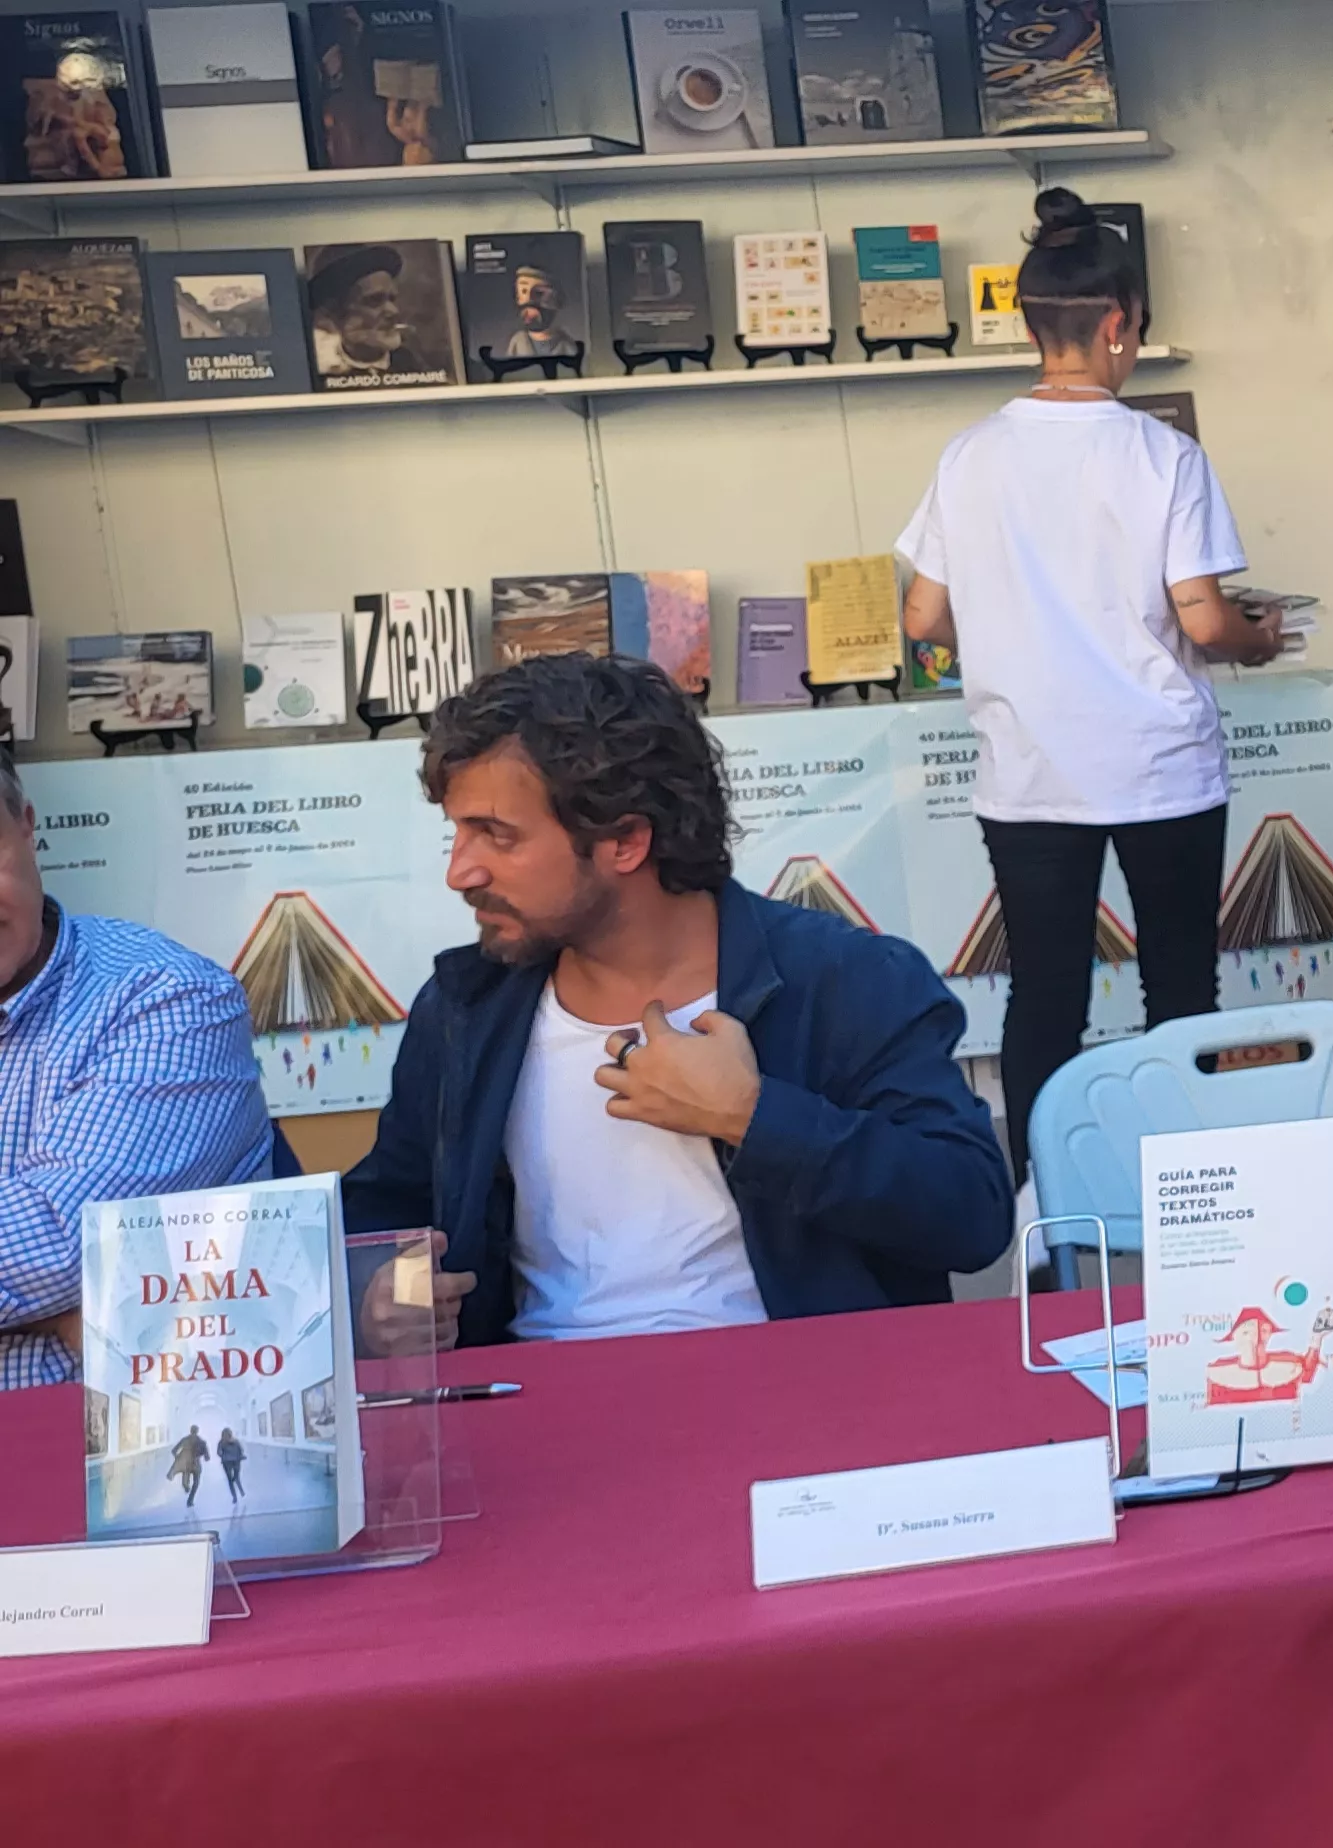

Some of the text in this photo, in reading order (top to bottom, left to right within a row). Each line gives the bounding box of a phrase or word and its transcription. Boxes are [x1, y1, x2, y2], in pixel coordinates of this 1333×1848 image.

[371, 10, 433, 24] SIGNOS
[664, 16, 724, 29] Orwell
[24, 20, 80, 37] Signos
[205, 64, 246, 80] Signos
[186, 354, 254, 368] LOS BAÑOS
[188, 367, 274, 381] DE PANTICOSA
[326, 375, 381, 388] RICARDO
[919, 731, 935, 742] 40
[1232, 718, 1333, 740] DEL LIBRO
[1229, 743, 1279, 760] ESCA
[759, 758, 864, 780] DEL LIBRO
[925, 771, 952, 787] DE
[184, 781, 253, 795] 40 Edición
[186, 794, 362, 819] FERIA DEL LIBRO
[44, 811, 110, 830] LIBRO
[188, 819, 301, 840] DE HUESCA
[1159, 1166, 1237, 1182] GUÍA PARA
[1158, 1181, 1235, 1197] CORREGIR
[1159, 1197, 1217, 1212] TEXTOS
[117, 1207, 292, 1230] ALEJANDRO CORRAL
[1160, 1208, 1255, 1226] DRAMÁTICOS
[184, 1238, 222, 1263] LA
[140, 1267, 271, 1306] DAMA
[175, 1313, 236, 1340] DEL
[130, 1344, 284, 1386] PRADO
[901, 1517, 949, 1533] Susana
[952, 1511, 995, 1525] Sierra
[0, 1602, 104, 1624] lejandro Corral
